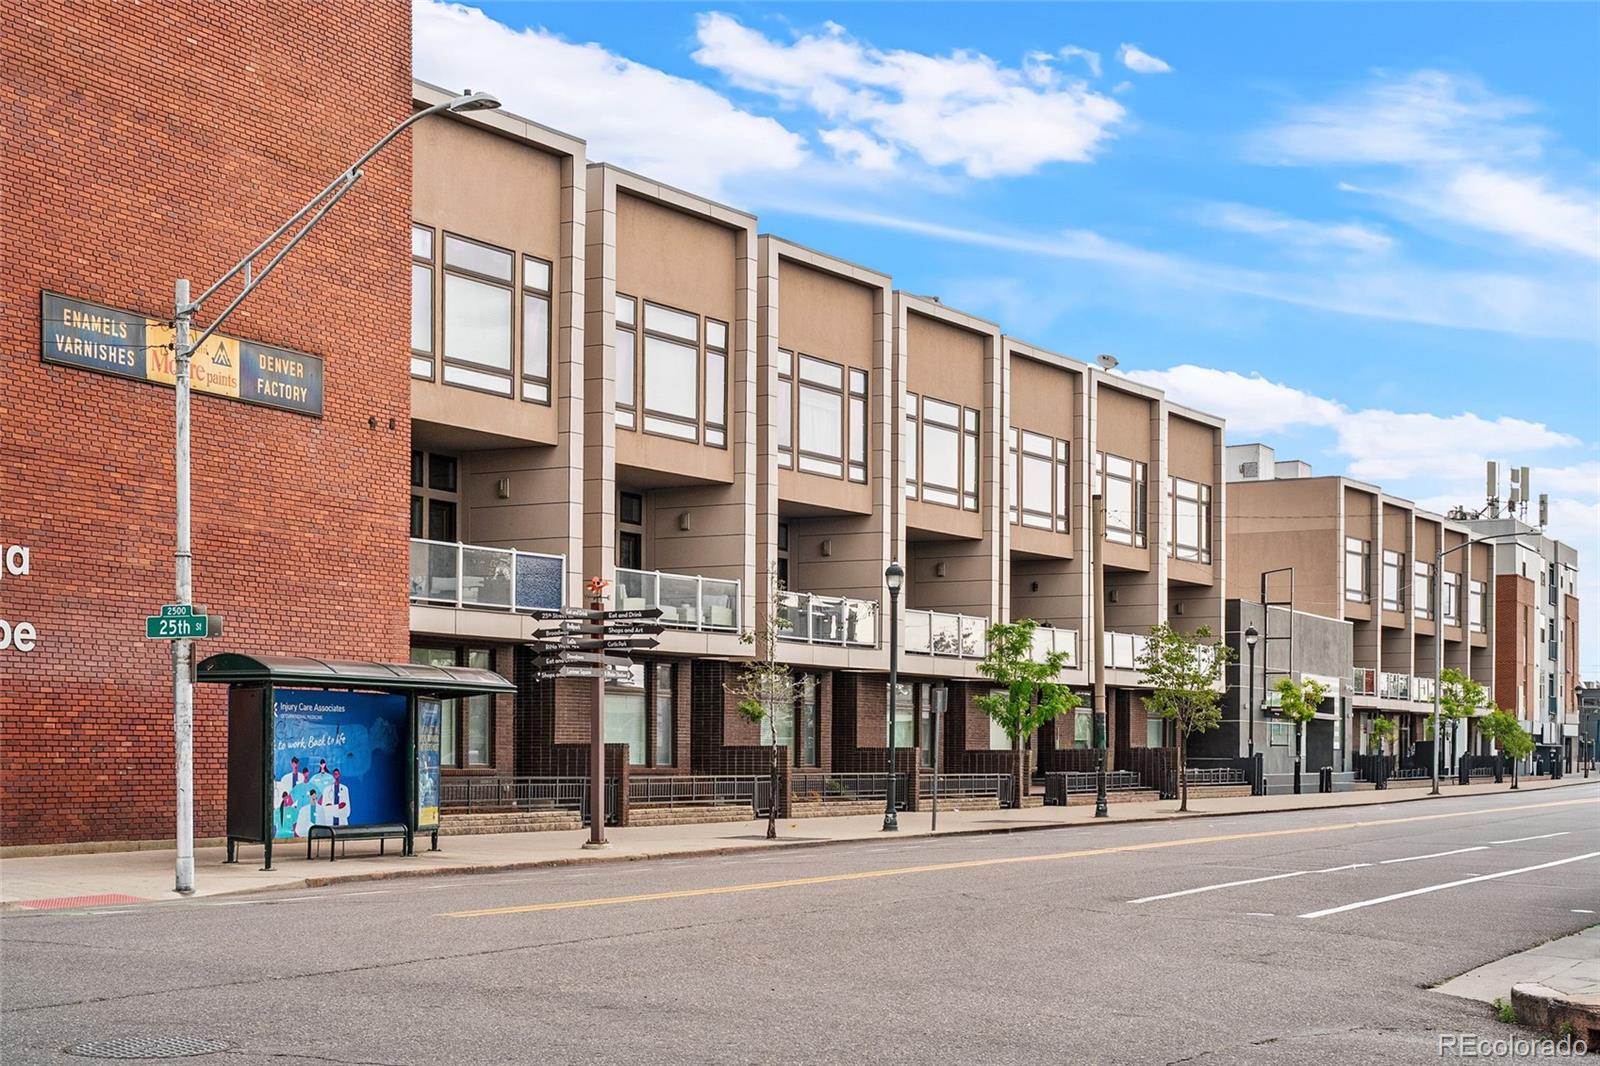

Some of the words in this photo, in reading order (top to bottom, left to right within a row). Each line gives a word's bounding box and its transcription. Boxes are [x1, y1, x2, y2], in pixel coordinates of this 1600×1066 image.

[63, 308, 128, 339] ENAMELS
[55, 333, 136, 368] VARNISHES
[259, 353, 304, 379] DENVER
[206, 371, 238, 389] paints
[257, 380, 308, 403] FACTORY
[0, 544, 30, 580] a
[167, 607, 187, 616] 2500
[159, 619, 191, 635] 25th
[195, 622, 202, 631] St
[281, 702, 298, 712] Injury
[299, 702, 312, 710] Care
[314, 704, 346, 712] Associates
[279, 740, 286, 750] to
[308, 736, 326, 748] Back
[327, 736, 334, 746] to
